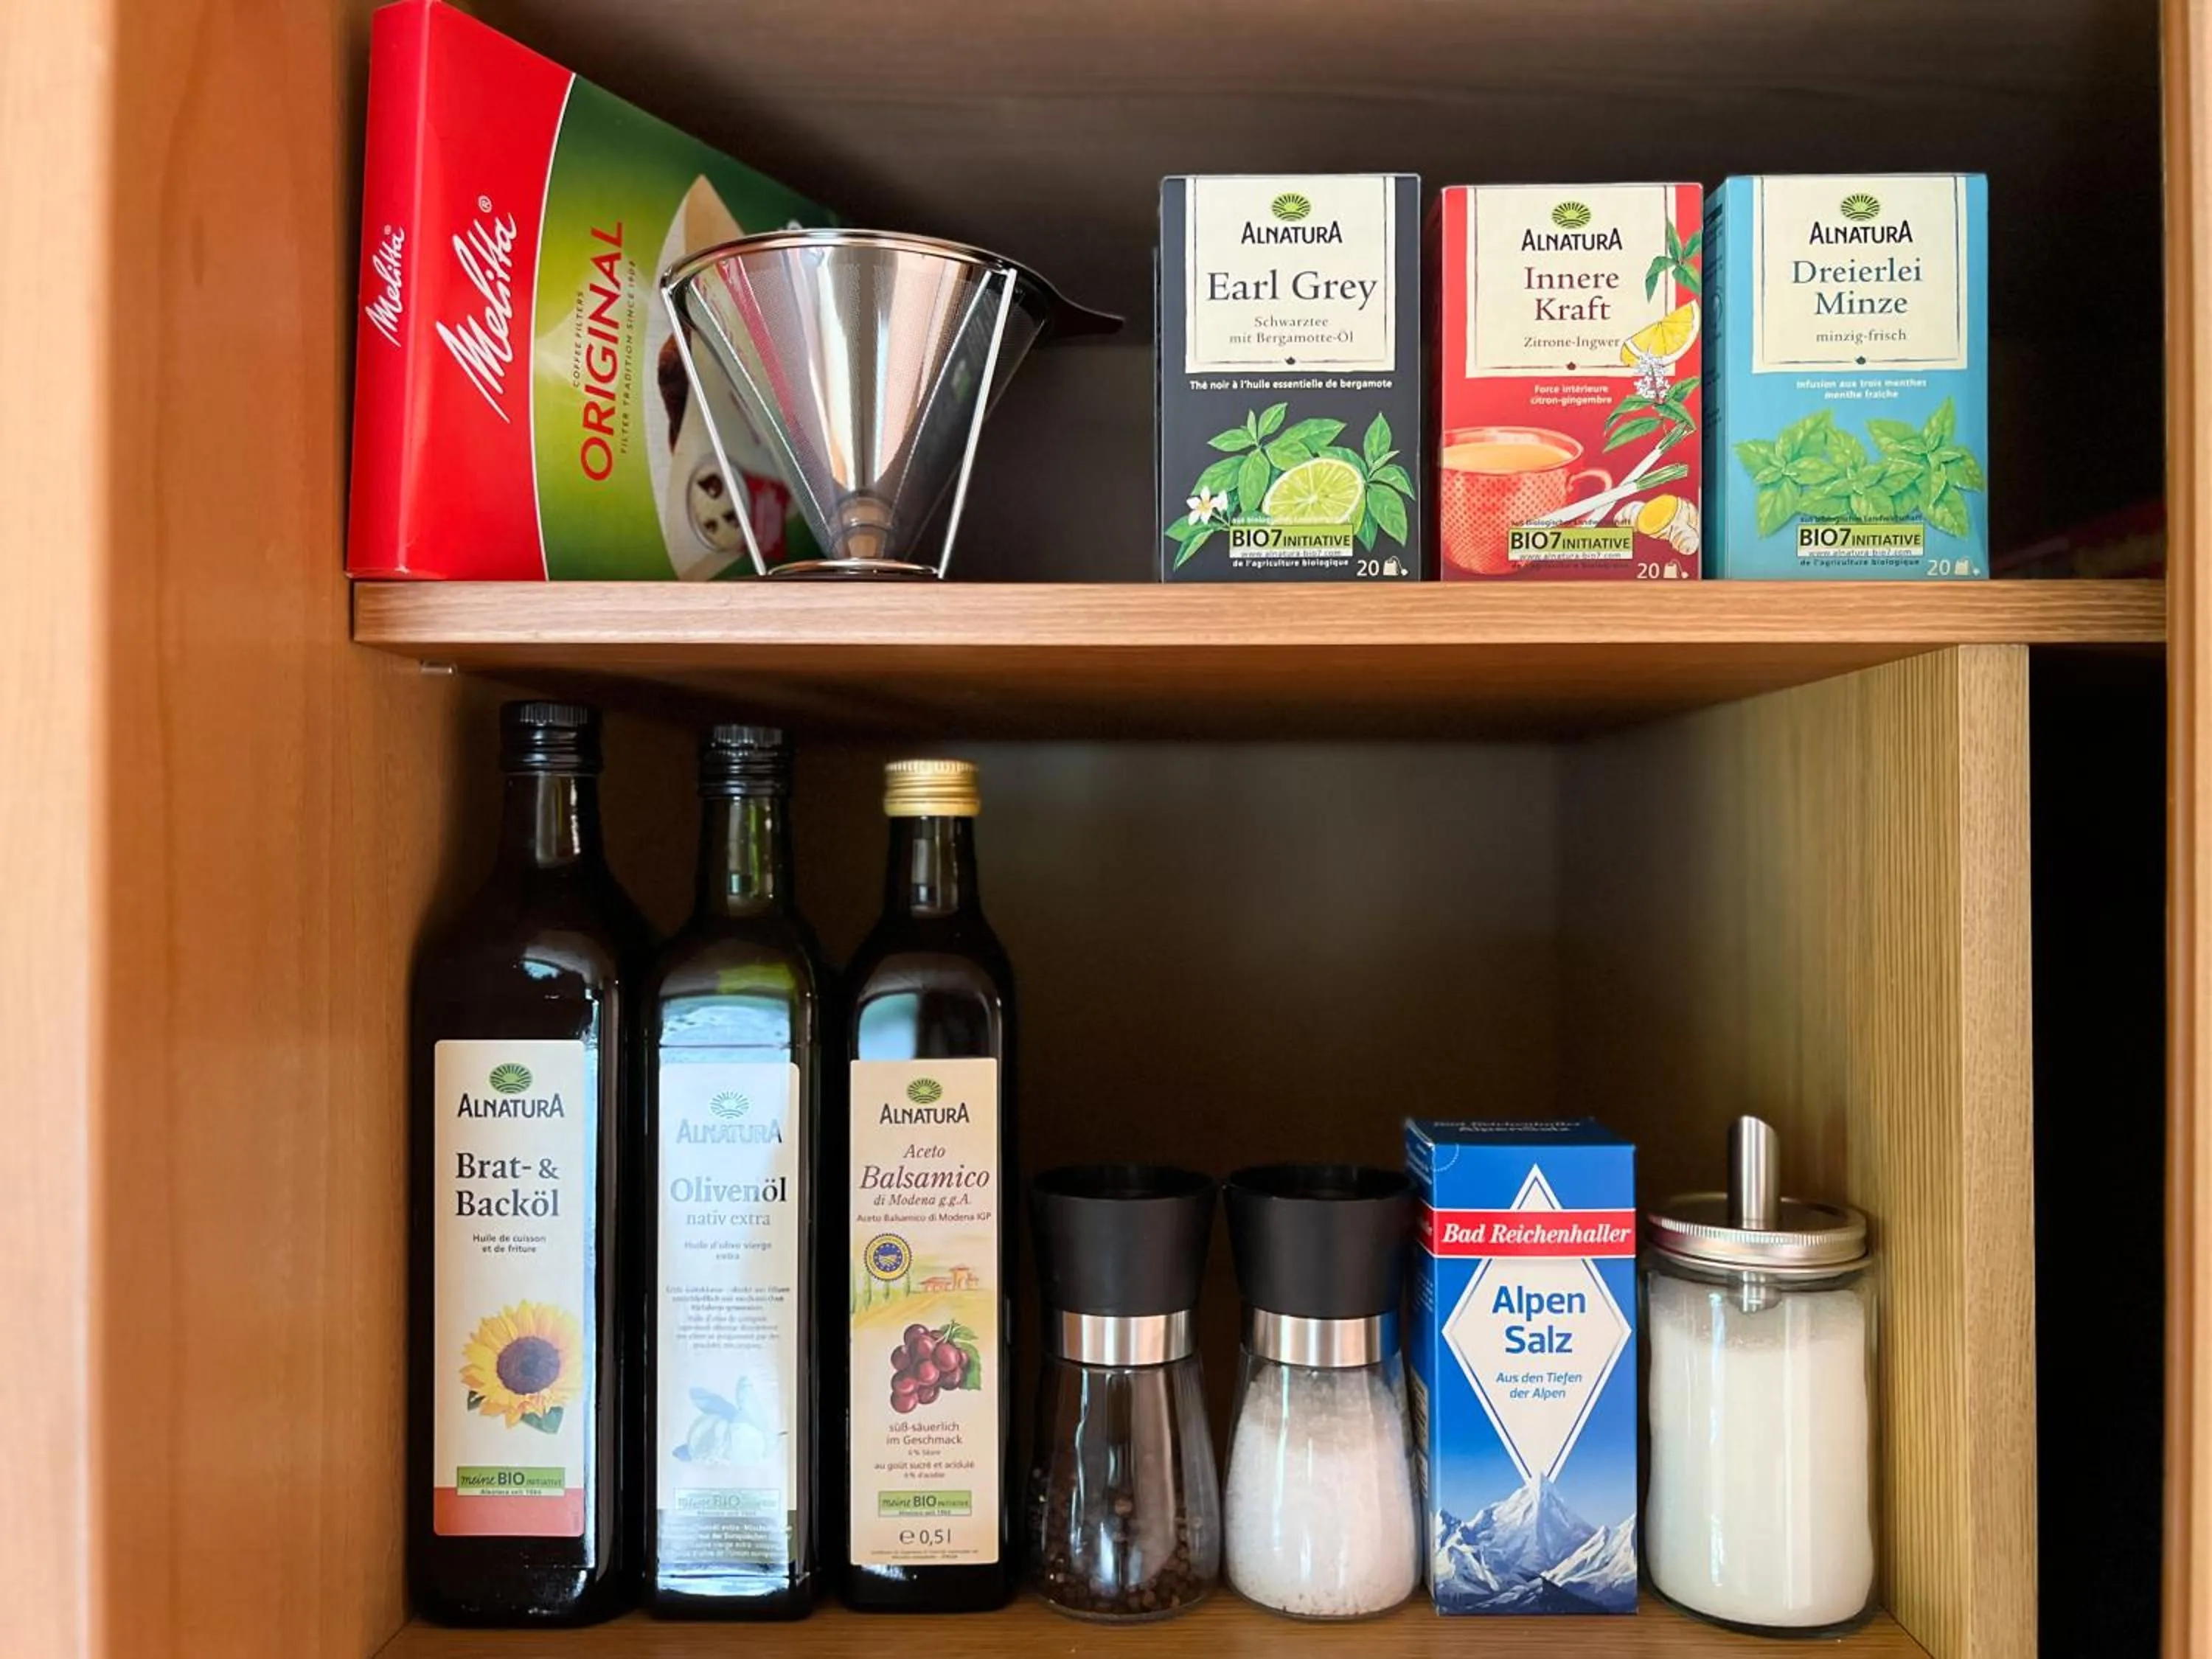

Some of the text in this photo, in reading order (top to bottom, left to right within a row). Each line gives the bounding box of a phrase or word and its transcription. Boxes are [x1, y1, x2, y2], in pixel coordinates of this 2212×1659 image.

[1241, 220, 1343, 244] ALNATURA
[1521, 228, 1623, 251] ALNATURA
[1809, 220, 1913, 244] ALNATURA
[1524, 266, 1620, 290] Innere
[1792, 257, 1923, 284] Dreierlei
[1206, 269, 1378, 310] Earl Grey
[626, 293, 635, 329] SINCE
[1534, 296, 1612, 321] Kraft
[1814, 291, 1908, 316] Minze
[1254, 316, 1329, 328] Schwarztee
[572, 291, 585, 388] COFFEE FILTERS
[1229, 330, 1354, 347] mit Bergamotte-Öl
[1523, 335, 1620, 350] Zitrone-Ingwer
[1816, 329, 1907, 344] minzig-frisch
[580, 222, 623, 481] ORIGINAL
[622, 335, 633, 406] TRADITION
[1189, 378, 1392, 391] Thé noir à l'huile essentielle de bergamote
[1534, 384, 1559, 393] Force
[1839, 380, 1857, 389] aux
[1860, 379, 1882, 388] trois
[1885, 378, 1927, 388] menthes
[1530, 395, 1613, 406] citron-gingembre
[1824, 390, 1862, 400] menthe
[620, 414, 629, 453] FILTER
[1301, 559, 1349, 568] biologique
[1357, 560, 1380, 577] 20
[1871, 558, 1919, 567] biologique
[1927, 560, 1950, 577] 20
[1636, 563, 1659, 580] 20
[457, 1093, 565, 1119] ALNATURA
[880, 1102, 970, 1124] ALNATURA
[903, 1144, 946, 1159] Aceto
[455, 1152, 560, 1180] Brat- &
[859, 1164, 990, 1189] Balsamico
[670, 1176, 786, 1203] Olivenöl
[455, 1189, 560, 1217] Backöl
[874, 1194, 886, 1206] di
[888, 1194, 936, 1206] Modena
[686, 1209, 771, 1227] nativ extra
[857, 1212, 992, 1222] Aceto Balsamico di Modena IGP
[473, 1234, 546, 1242] Huile de cuisson
[1442, 1223, 1486, 1244] Bad
[1490, 1222, 1632, 1245] Reichenhaller
[494, 1245, 505, 1253] de
[508, 1245, 537, 1253] friture
[743, 1241, 772, 1251] vierge
[1492, 1285, 1586, 1321] Alpen
[1505, 1326, 1573, 1354] Salz
[1496, 1371, 1582, 1386] Aus den Tiefen
[1509, 1387, 1566, 1401] der Alpen
[888, 1422, 959, 1433] süß-säuerlich
[886, 1435, 962, 1445] im Geschmack
[910, 1461, 932, 1470] sucré
[933, 1461, 943, 1470] et
[945, 1460, 975, 1470] acidulé
[498, 1472, 525, 1486] BIO
[913, 1495, 936, 1508] BIO
[919, 1529, 944, 1546] 0,5
